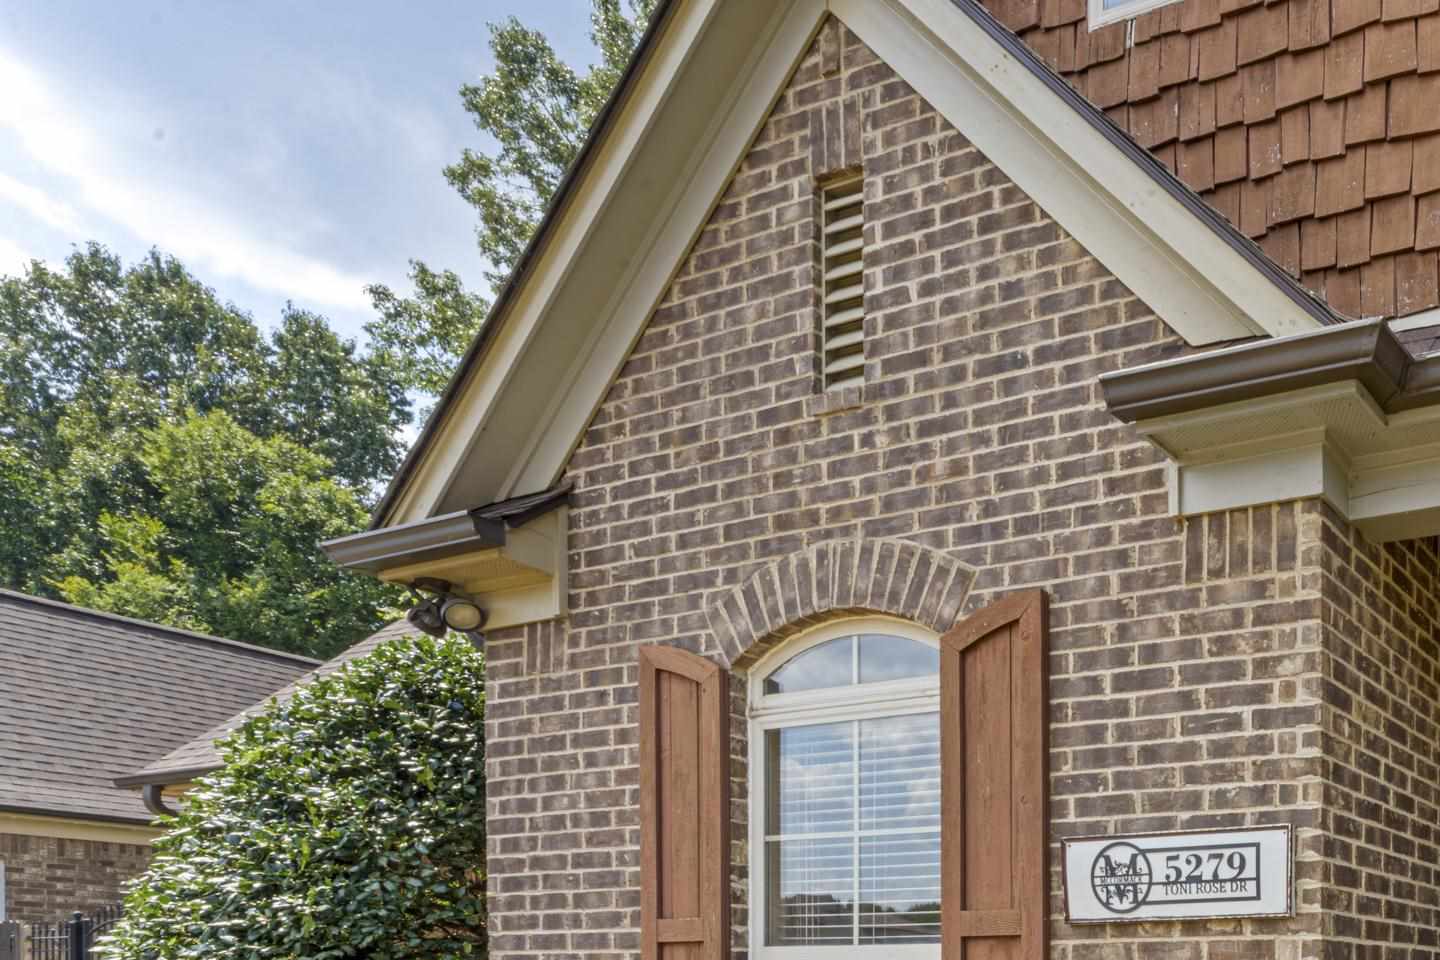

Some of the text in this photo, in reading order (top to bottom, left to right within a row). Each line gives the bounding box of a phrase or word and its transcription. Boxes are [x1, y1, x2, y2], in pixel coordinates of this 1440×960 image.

[1164, 851, 1246, 882] 5279
[1162, 880, 1248, 896] TONI ROSE DR
